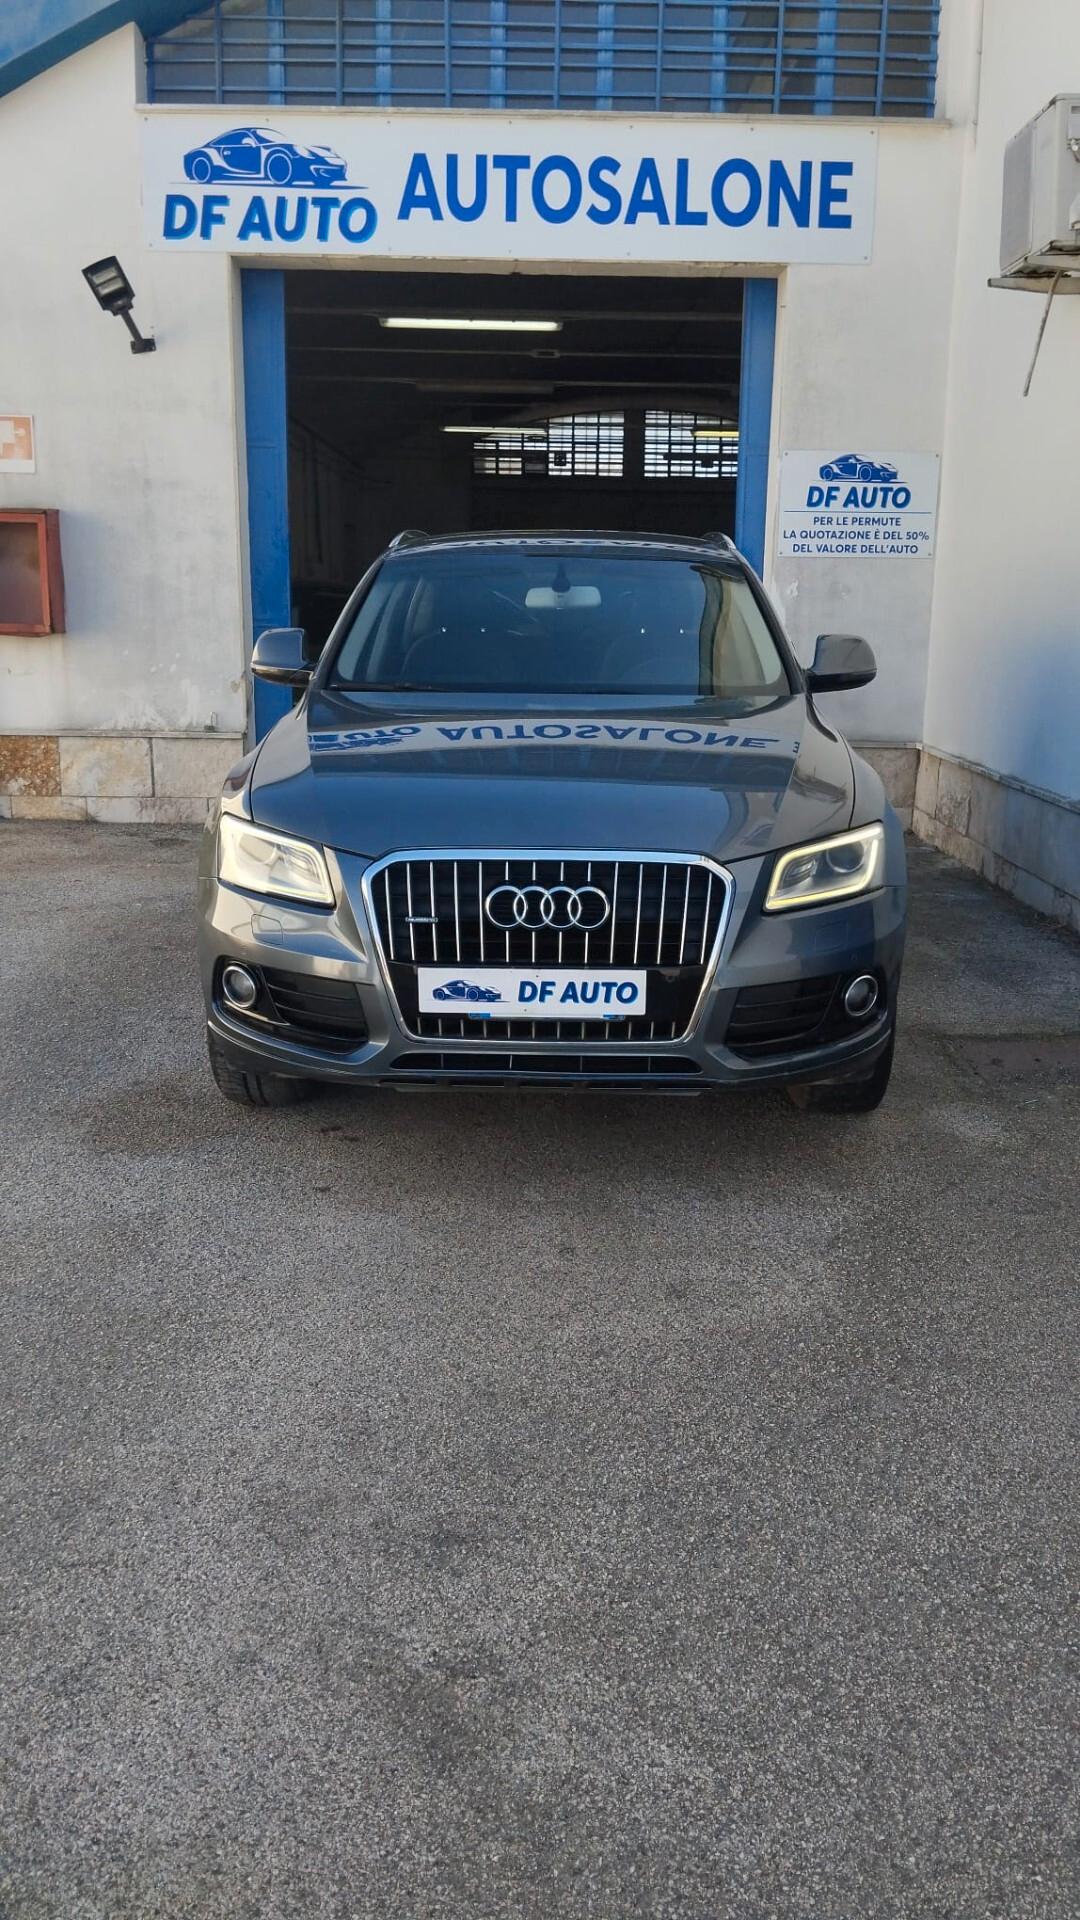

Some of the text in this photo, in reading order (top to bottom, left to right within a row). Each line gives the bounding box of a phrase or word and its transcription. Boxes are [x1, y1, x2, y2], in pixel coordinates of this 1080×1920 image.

[398, 152, 854, 230] AUTOSALONE
[163, 194, 378, 243] DF AUTO
[806, 486, 911, 509] DF AUTO
[813, 516, 901, 526] PER LE PERMUTE
[783, 529, 929, 540] LA QUOTAZIONE È DEL 50%
[792, 543, 918, 554] DEL VALORE DELL'AUTO
[518, 980, 639, 1004] DF AUTO
